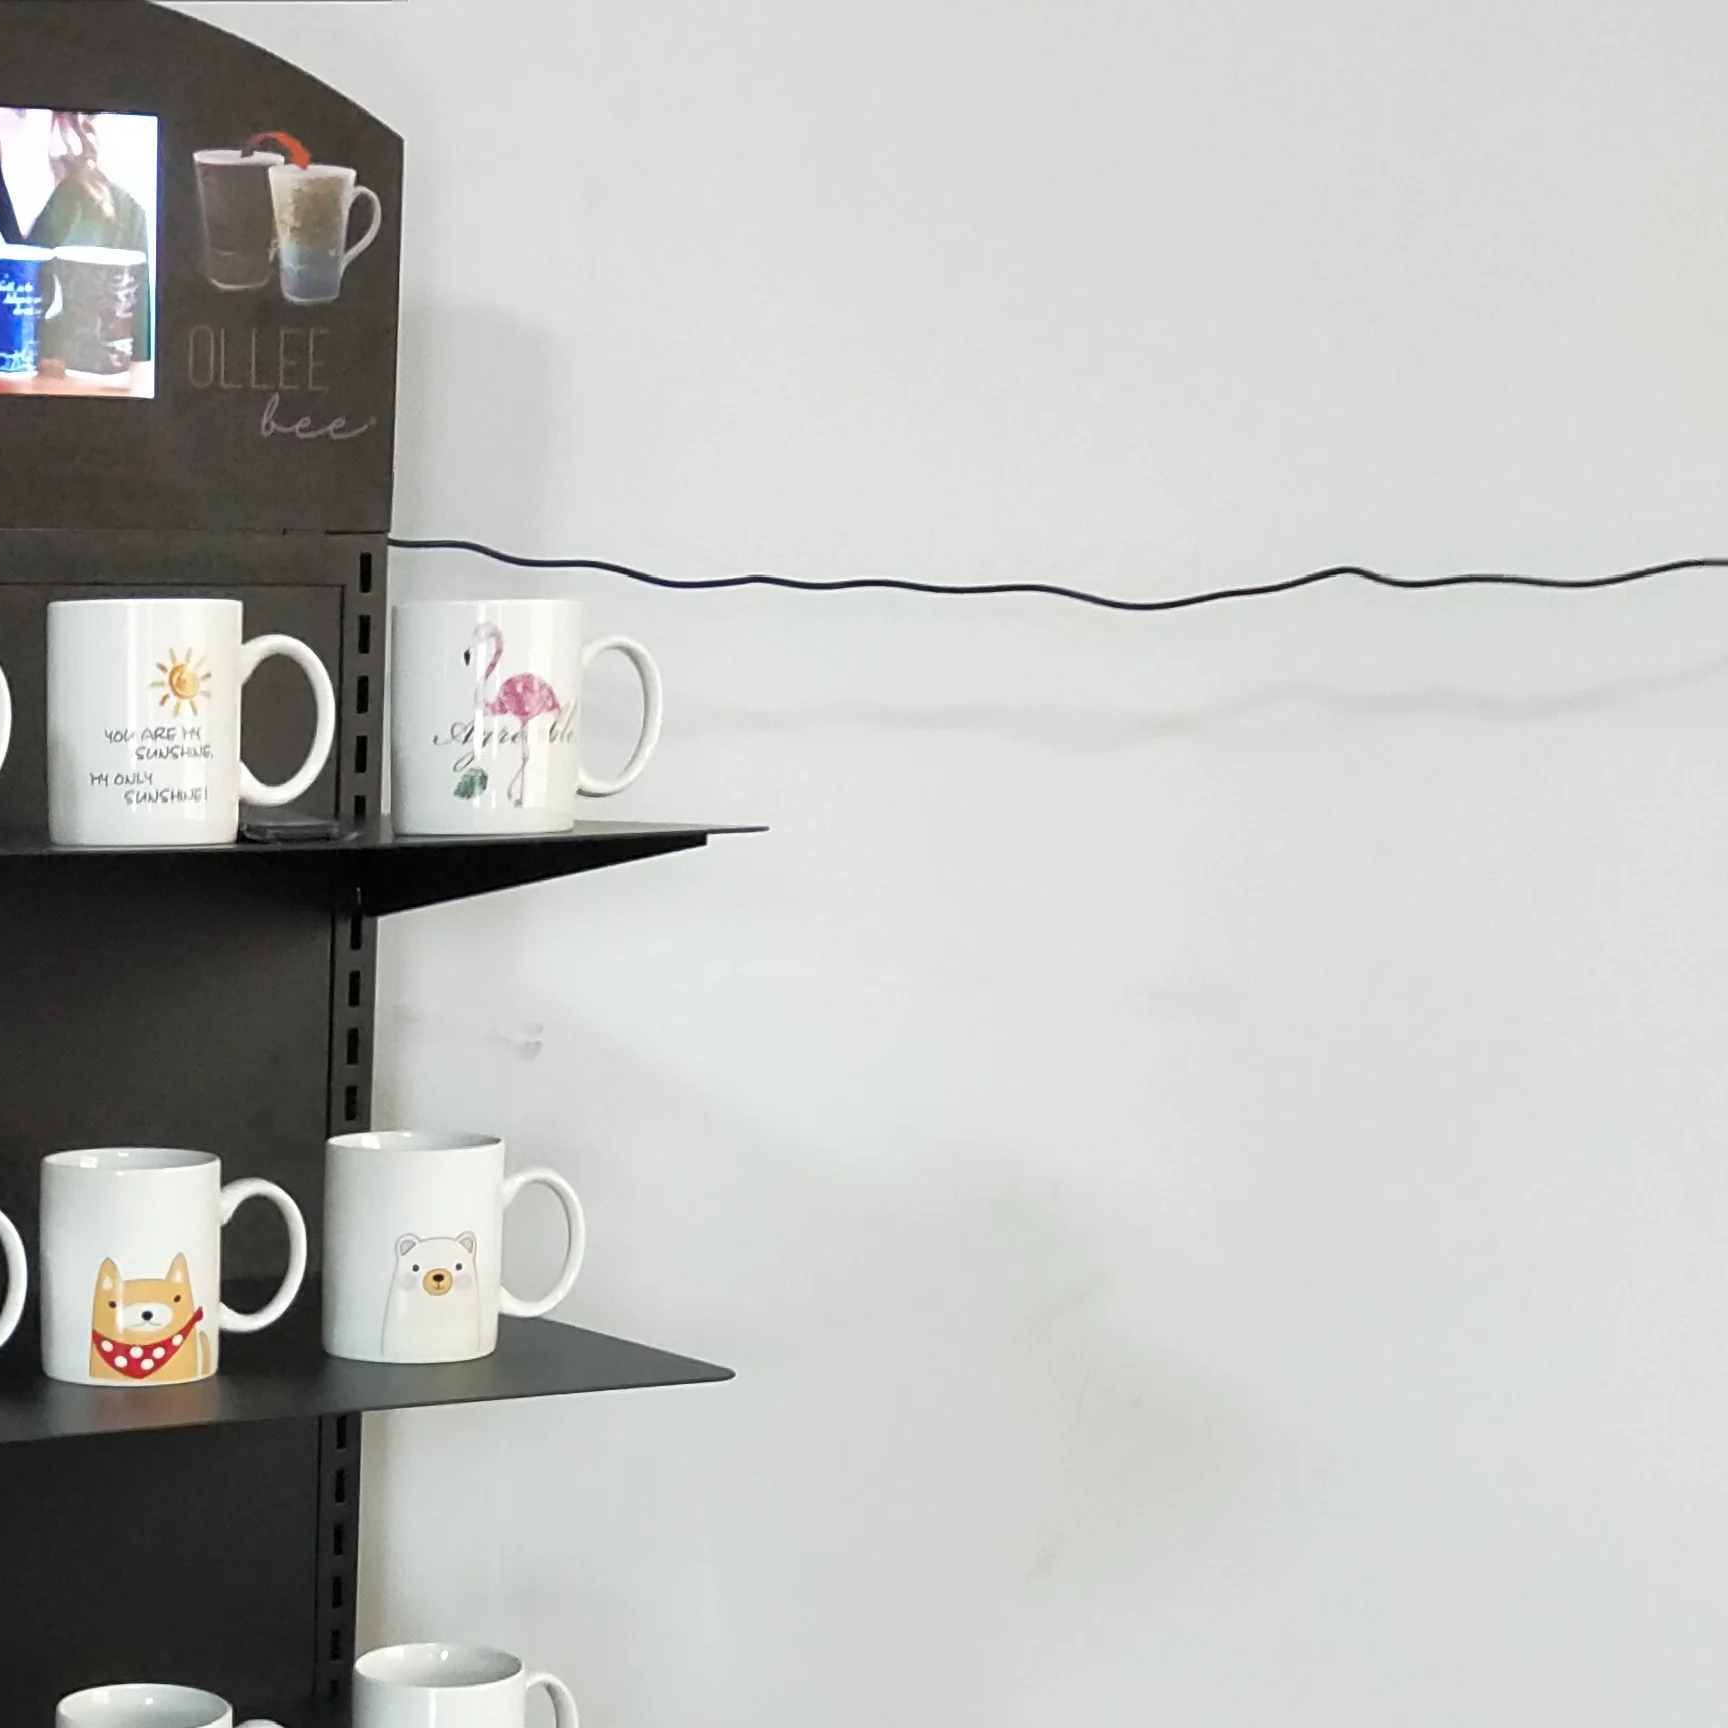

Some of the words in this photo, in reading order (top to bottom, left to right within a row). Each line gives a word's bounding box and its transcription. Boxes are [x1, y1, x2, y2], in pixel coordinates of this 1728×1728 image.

[188, 324, 330, 391] OLLEE
[260, 391, 376, 440] bee
[104, 727, 135, 745] YOU
[140, 726, 177, 742] ARE
[181, 726, 202, 742] MY
[89, 771, 109, 787] MY
[113, 771, 154, 787] ONLY
[123, 787, 209, 806] SUNSHINE!
